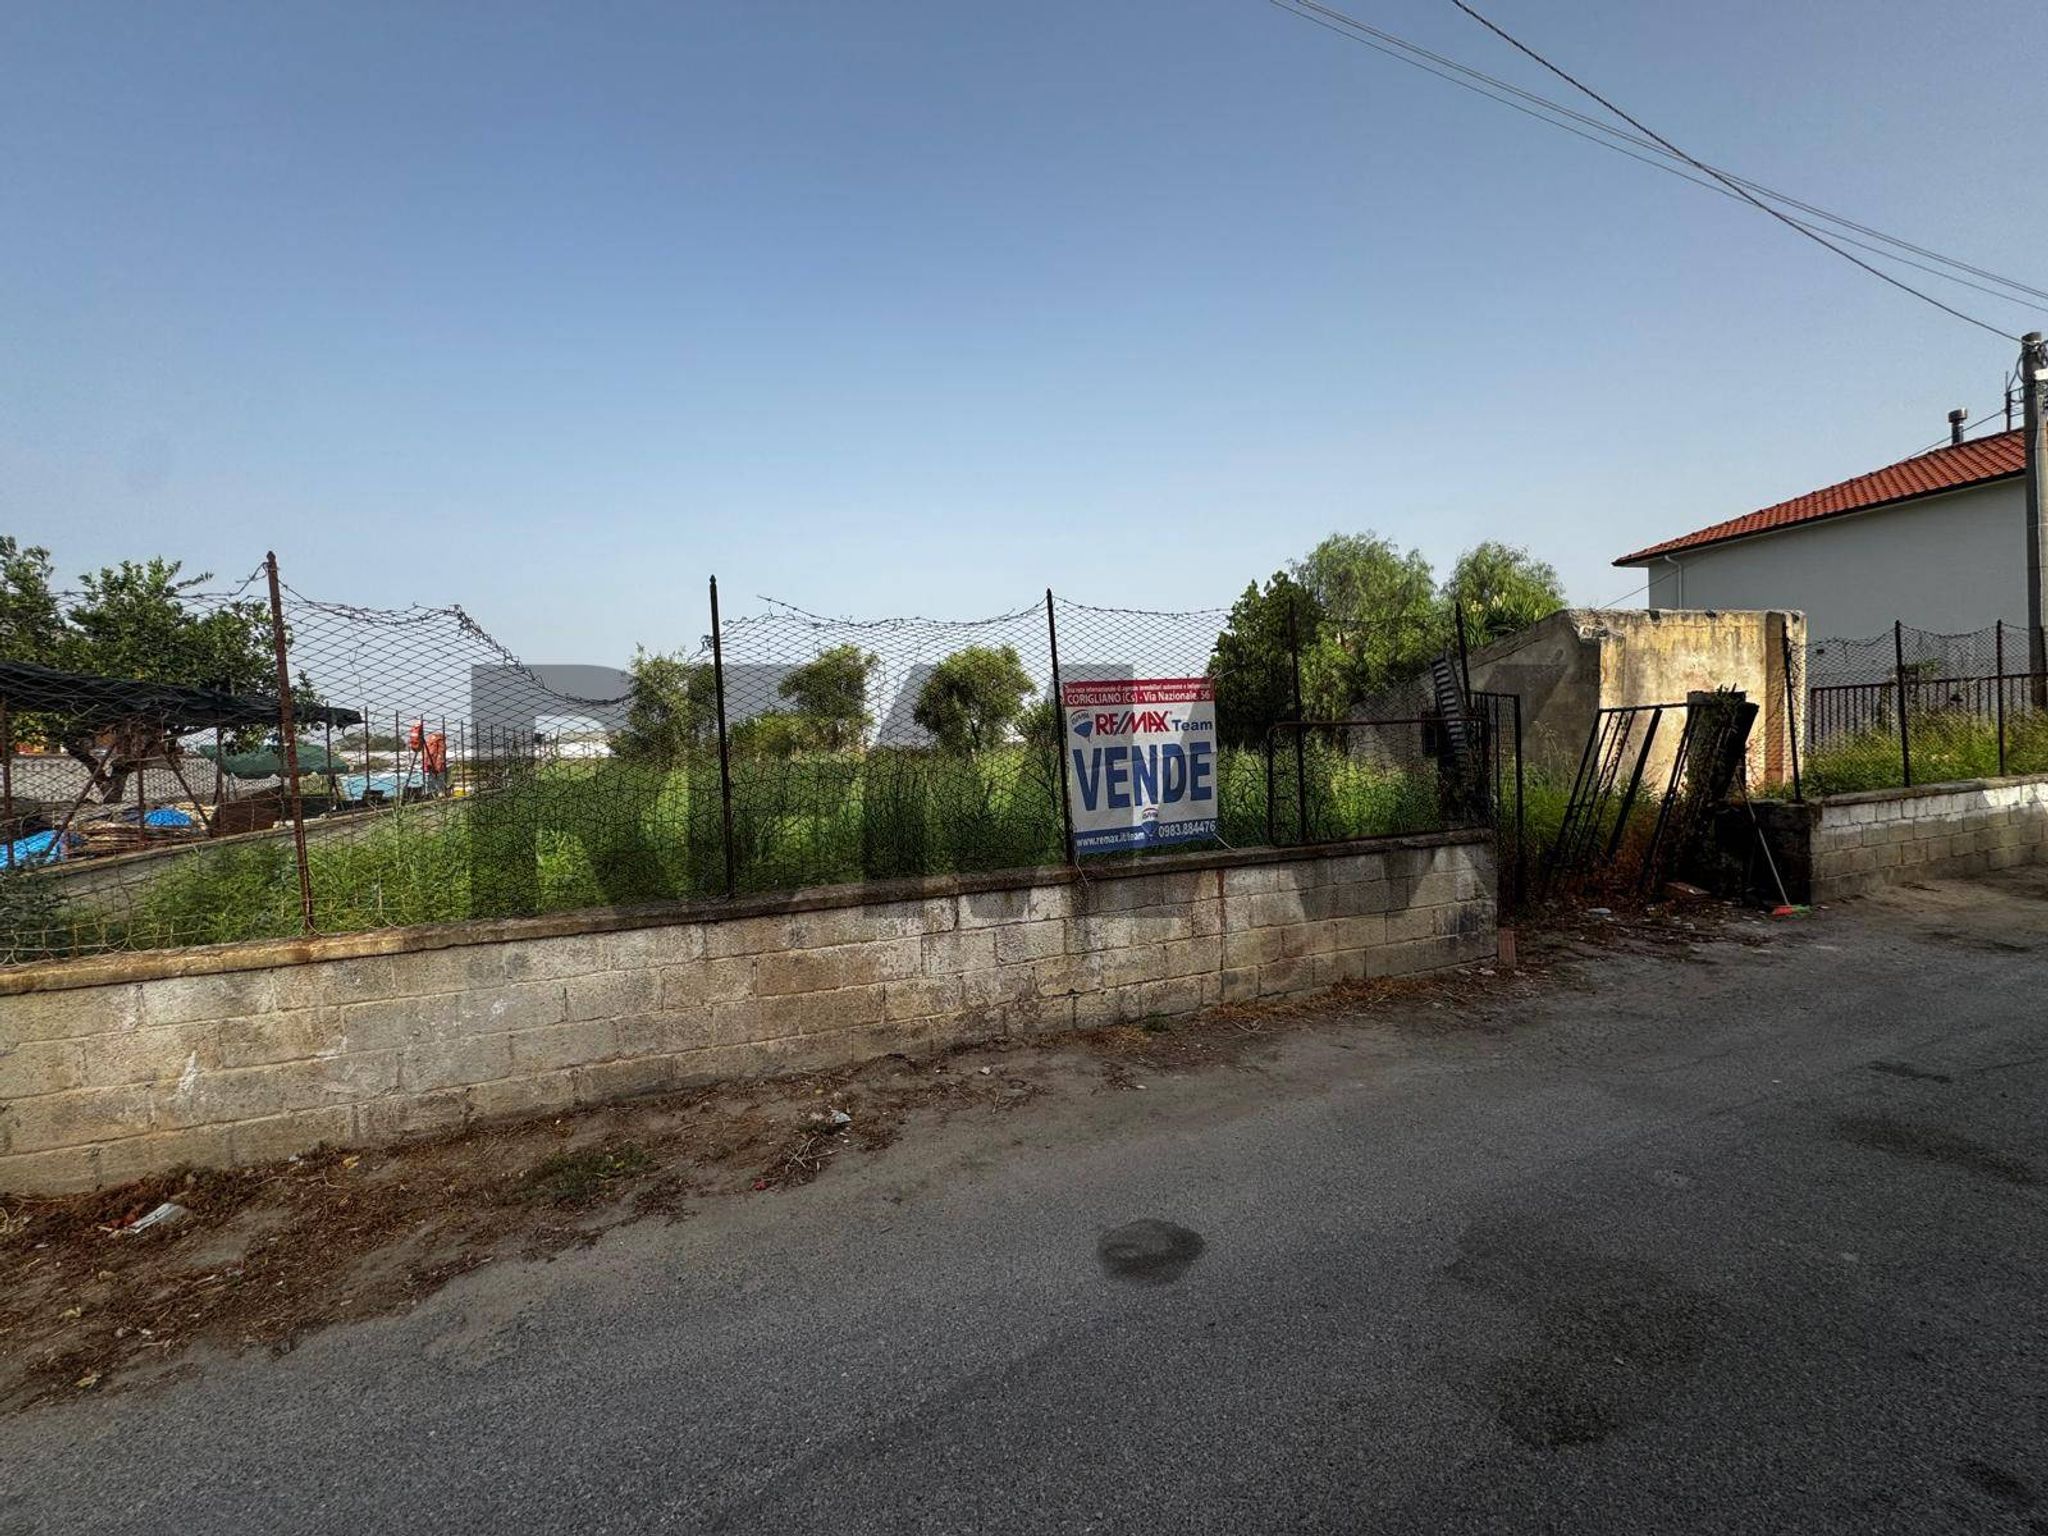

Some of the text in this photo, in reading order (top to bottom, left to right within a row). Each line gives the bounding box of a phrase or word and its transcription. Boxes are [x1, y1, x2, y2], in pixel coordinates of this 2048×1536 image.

[1067, 692, 1121, 705] CORIGLIANO
[1143, 691, 1156, 702] Via
[1094, 710, 1170, 736] RE/MAX
[1172, 719, 1213, 732] Team
[1072, 741, 1212, 811] VENDE
